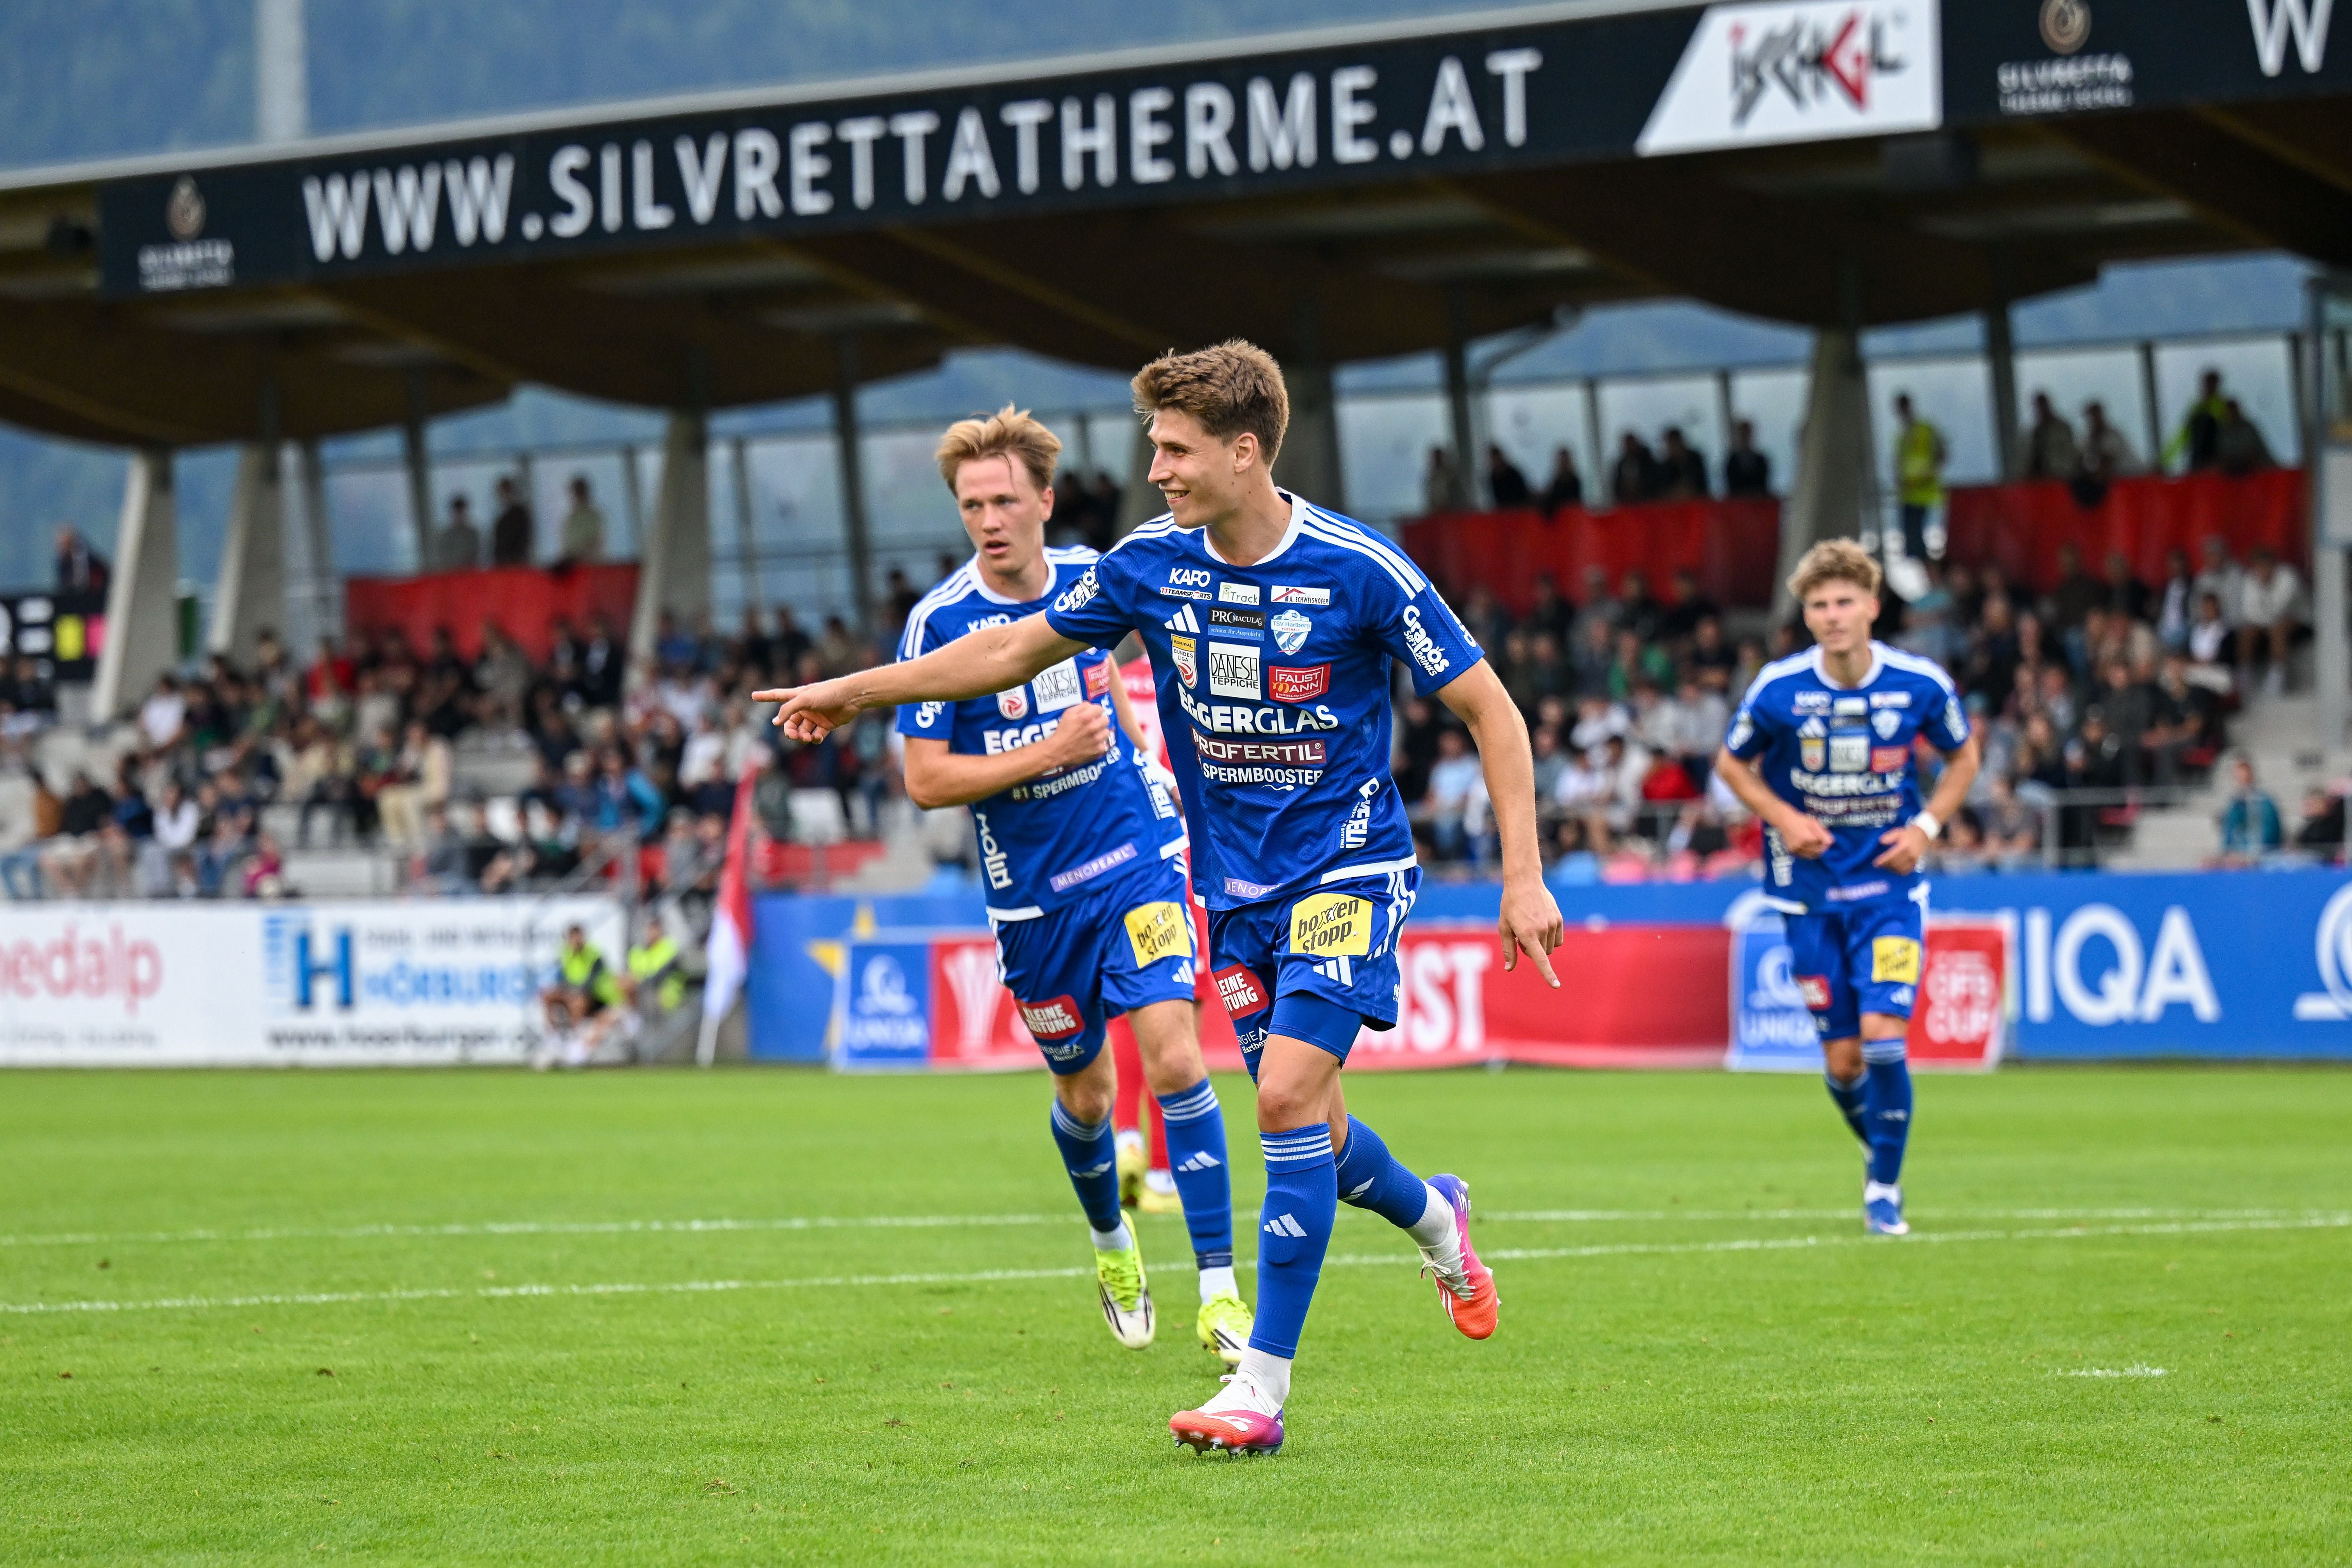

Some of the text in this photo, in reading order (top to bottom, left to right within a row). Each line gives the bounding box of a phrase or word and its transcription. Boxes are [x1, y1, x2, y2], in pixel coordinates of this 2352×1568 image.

[301, 47, 1543, 262] WWW.SILVRETTATHERME.AT
[1169, 568, 1211, 587] KAPO
[1173, 640, 1194, 648] ADMIRAL
[1174, 649, 1194, 658] BUNDES
[1404, 630, 1438, 676] SOFT DRINKS
[1211, 652, 1258, 681] DANESH
[1212, 677, 1259, 689] TEPPICHE
[1279, 671, 1321, 683] FAUST
[1178, 682, 1338, 734] EGGERGLAS
